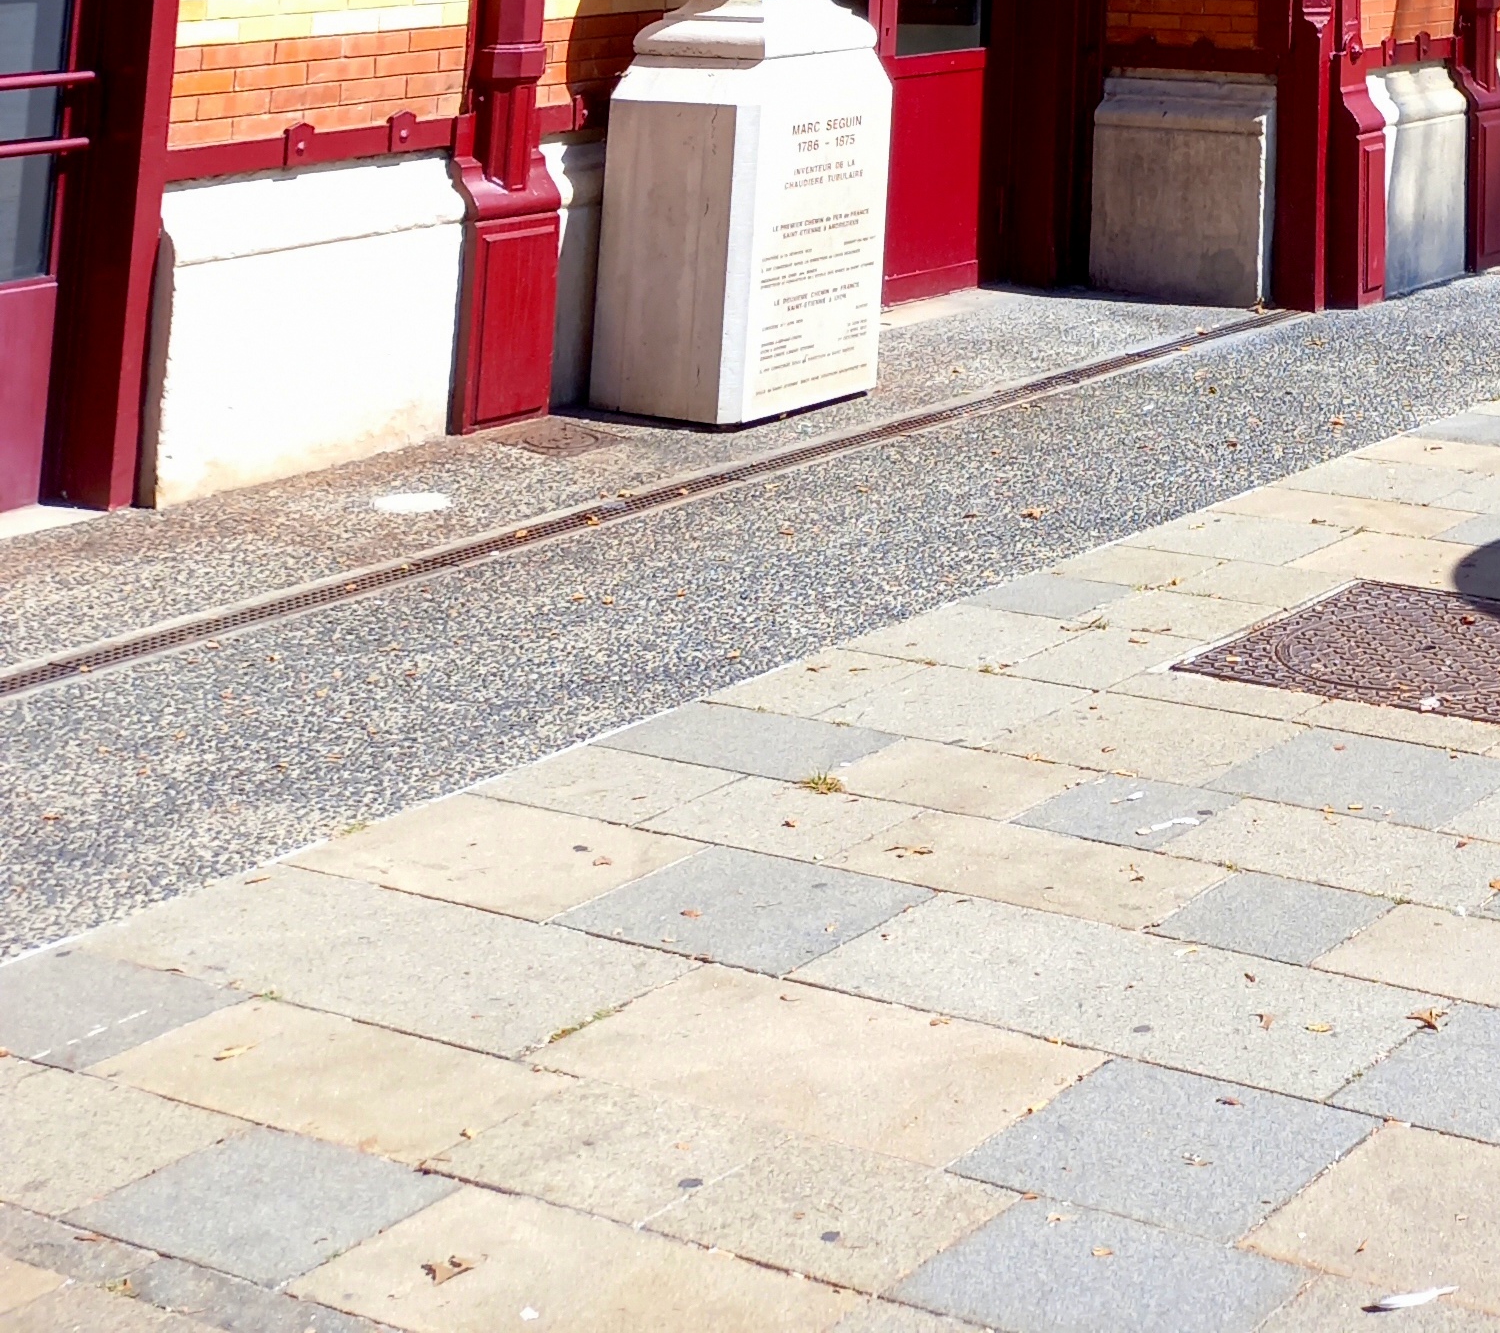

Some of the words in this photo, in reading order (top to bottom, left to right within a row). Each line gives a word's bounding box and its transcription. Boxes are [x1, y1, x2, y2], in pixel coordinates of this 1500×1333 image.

[792, 121, 821, 136] MARC
[826, 115, 862, 131] SEGUIN
[798, 139, 820, 153] 1786
[835, 134, 855, 148] 1875
[794, 162, 832, 176] INVENTEUR
[835, 160, 843, 169] DE
[847, 159, 855, 168] LA
